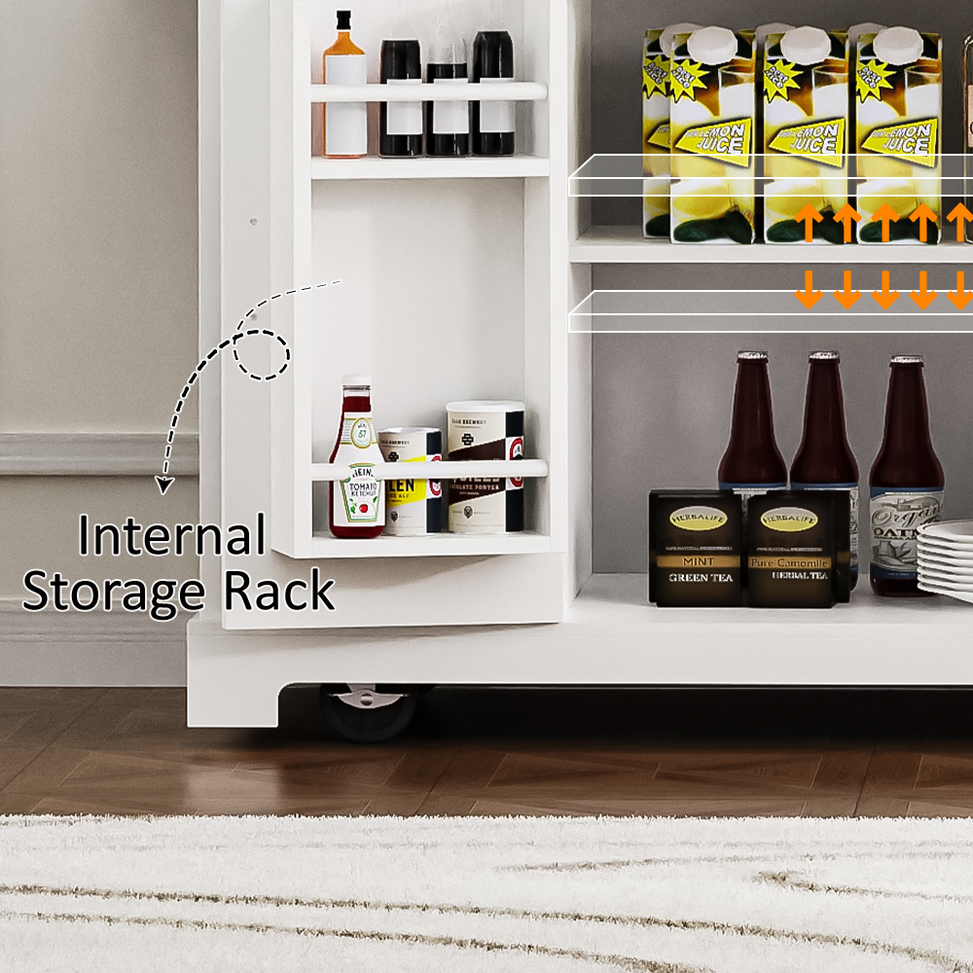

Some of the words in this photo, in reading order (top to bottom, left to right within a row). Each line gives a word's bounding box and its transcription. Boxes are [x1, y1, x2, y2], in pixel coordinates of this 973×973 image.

[702, 123, 745, 137] LEMON
[794, 123, 839, 137] LEMON
[886, 123, 932, 137] LEMON
[696, 137, 744, 155] JUICE
[790, 137, 837, 155] JUICE
[883, 137, 930, 155] JUICE
[358, 429, 367, 438] 57
[349, 483, 378, 491] TOMATO
[672, 514, 725, 523] HERBALIFE
[762, 514, 816, 524] HERBALIFE
[683, 557, 715, 566] MINT
[751, 558, 774, 568] Pure
[777, 558, 829, 568] Camomile
[668, 573, 708, 583] GREEN
[709, 573, 734, 583] TEA
[771, 571, 809, 579] HERBAL
[809, 571, 829, 579] TEA
